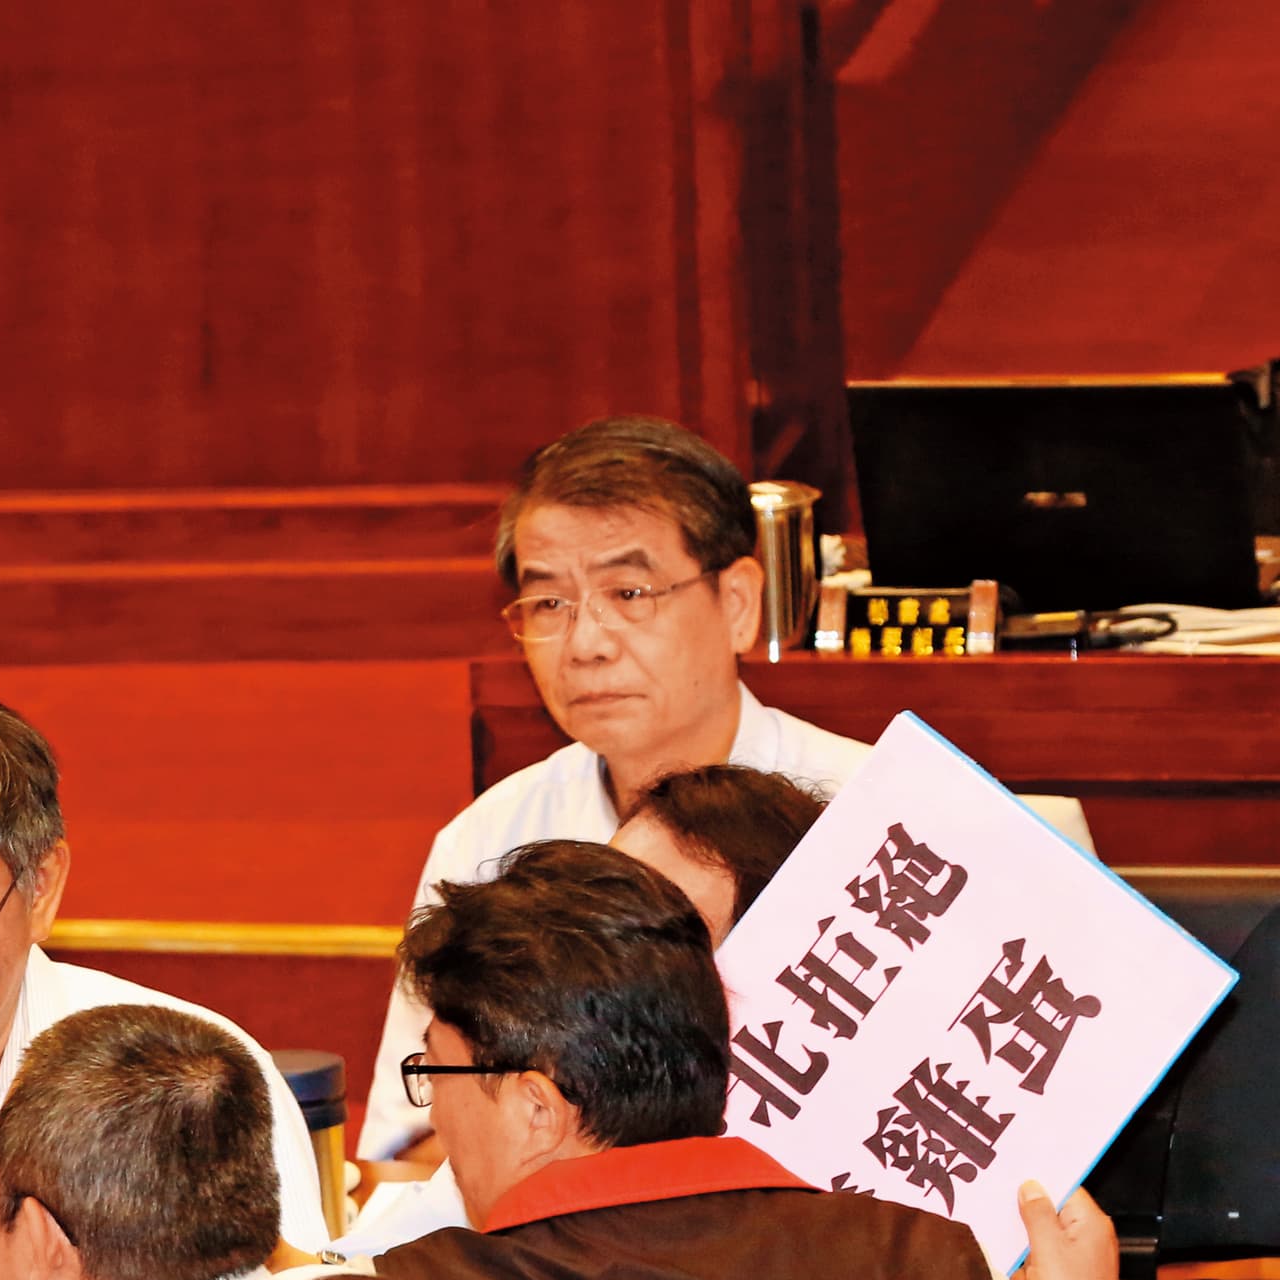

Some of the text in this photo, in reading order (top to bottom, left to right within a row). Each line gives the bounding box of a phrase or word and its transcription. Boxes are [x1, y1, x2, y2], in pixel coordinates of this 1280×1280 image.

[720, 822, 969, 1137] 北拒絕
[829, 937, 1102, 1217] 雞蛋
